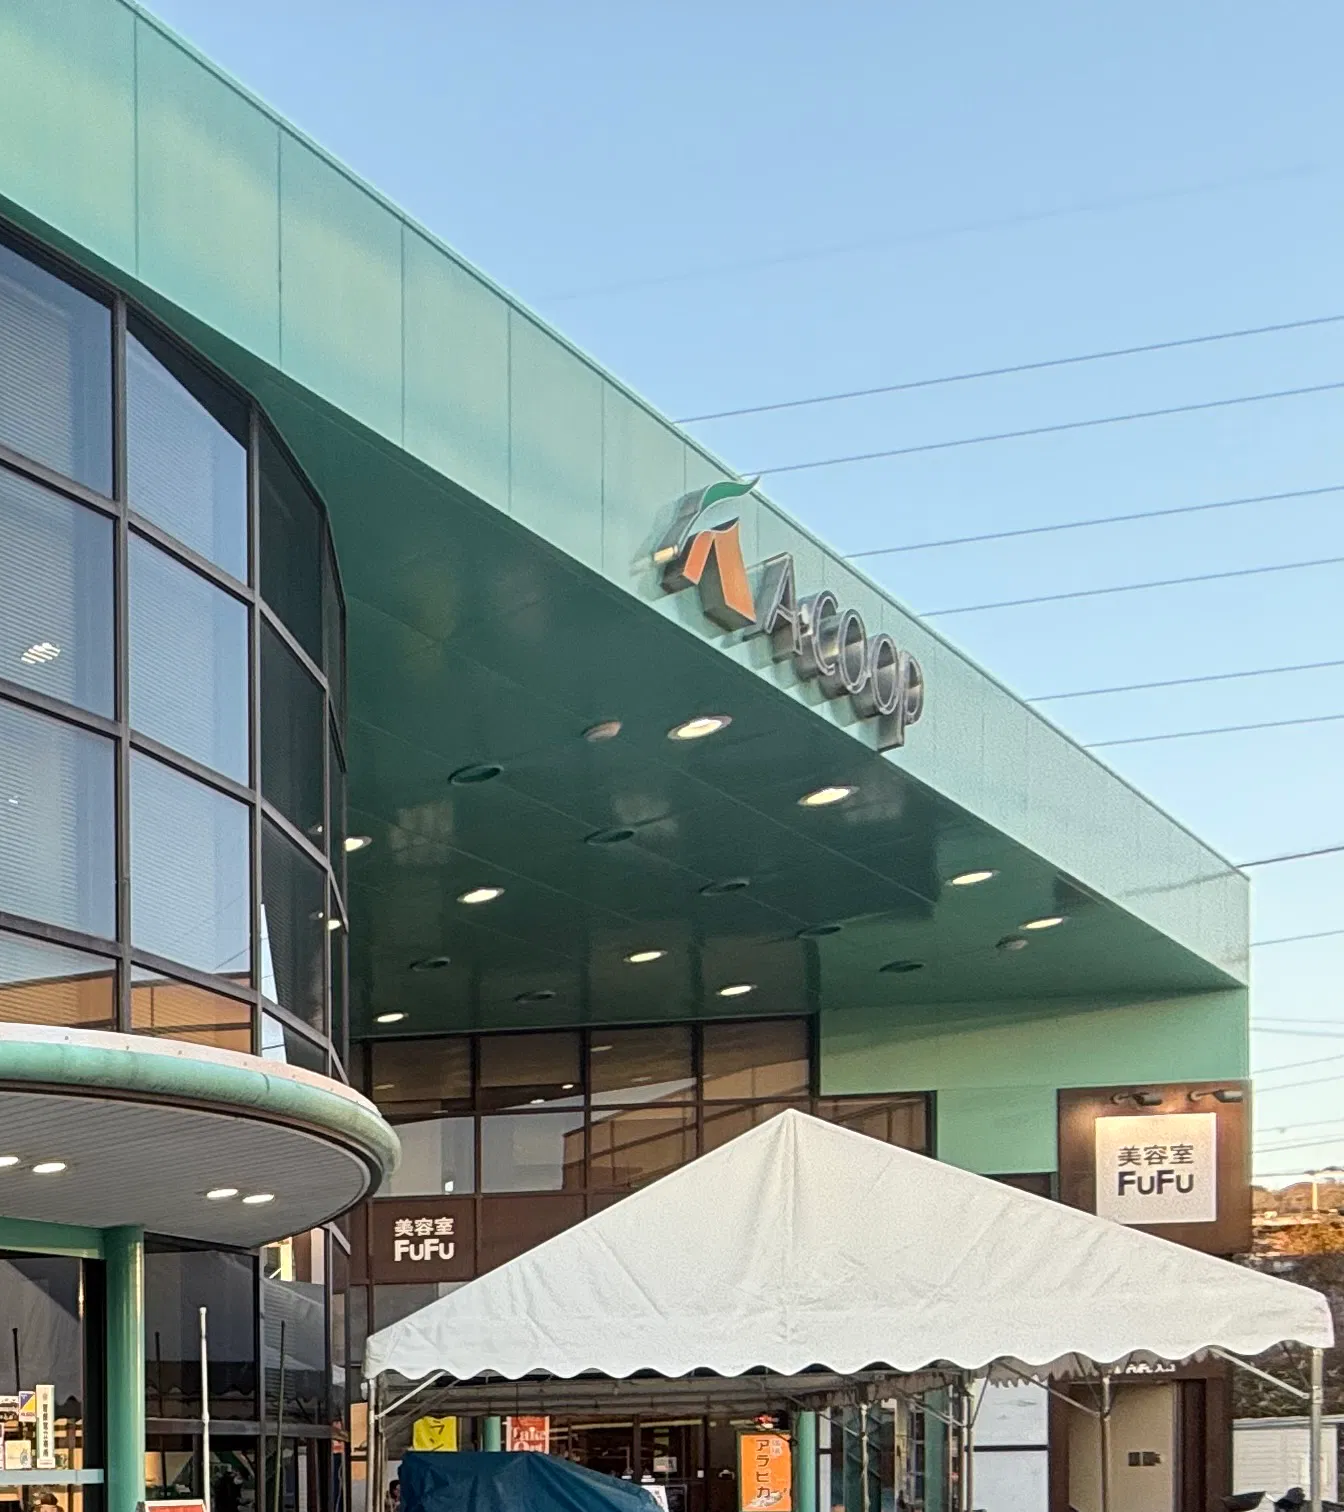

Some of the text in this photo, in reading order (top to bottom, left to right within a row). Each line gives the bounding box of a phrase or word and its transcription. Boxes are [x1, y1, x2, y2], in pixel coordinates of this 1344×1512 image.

[1118, 1144, 1195, 1167] 美容室
[394, 1217, 455, 1238] 美容室
